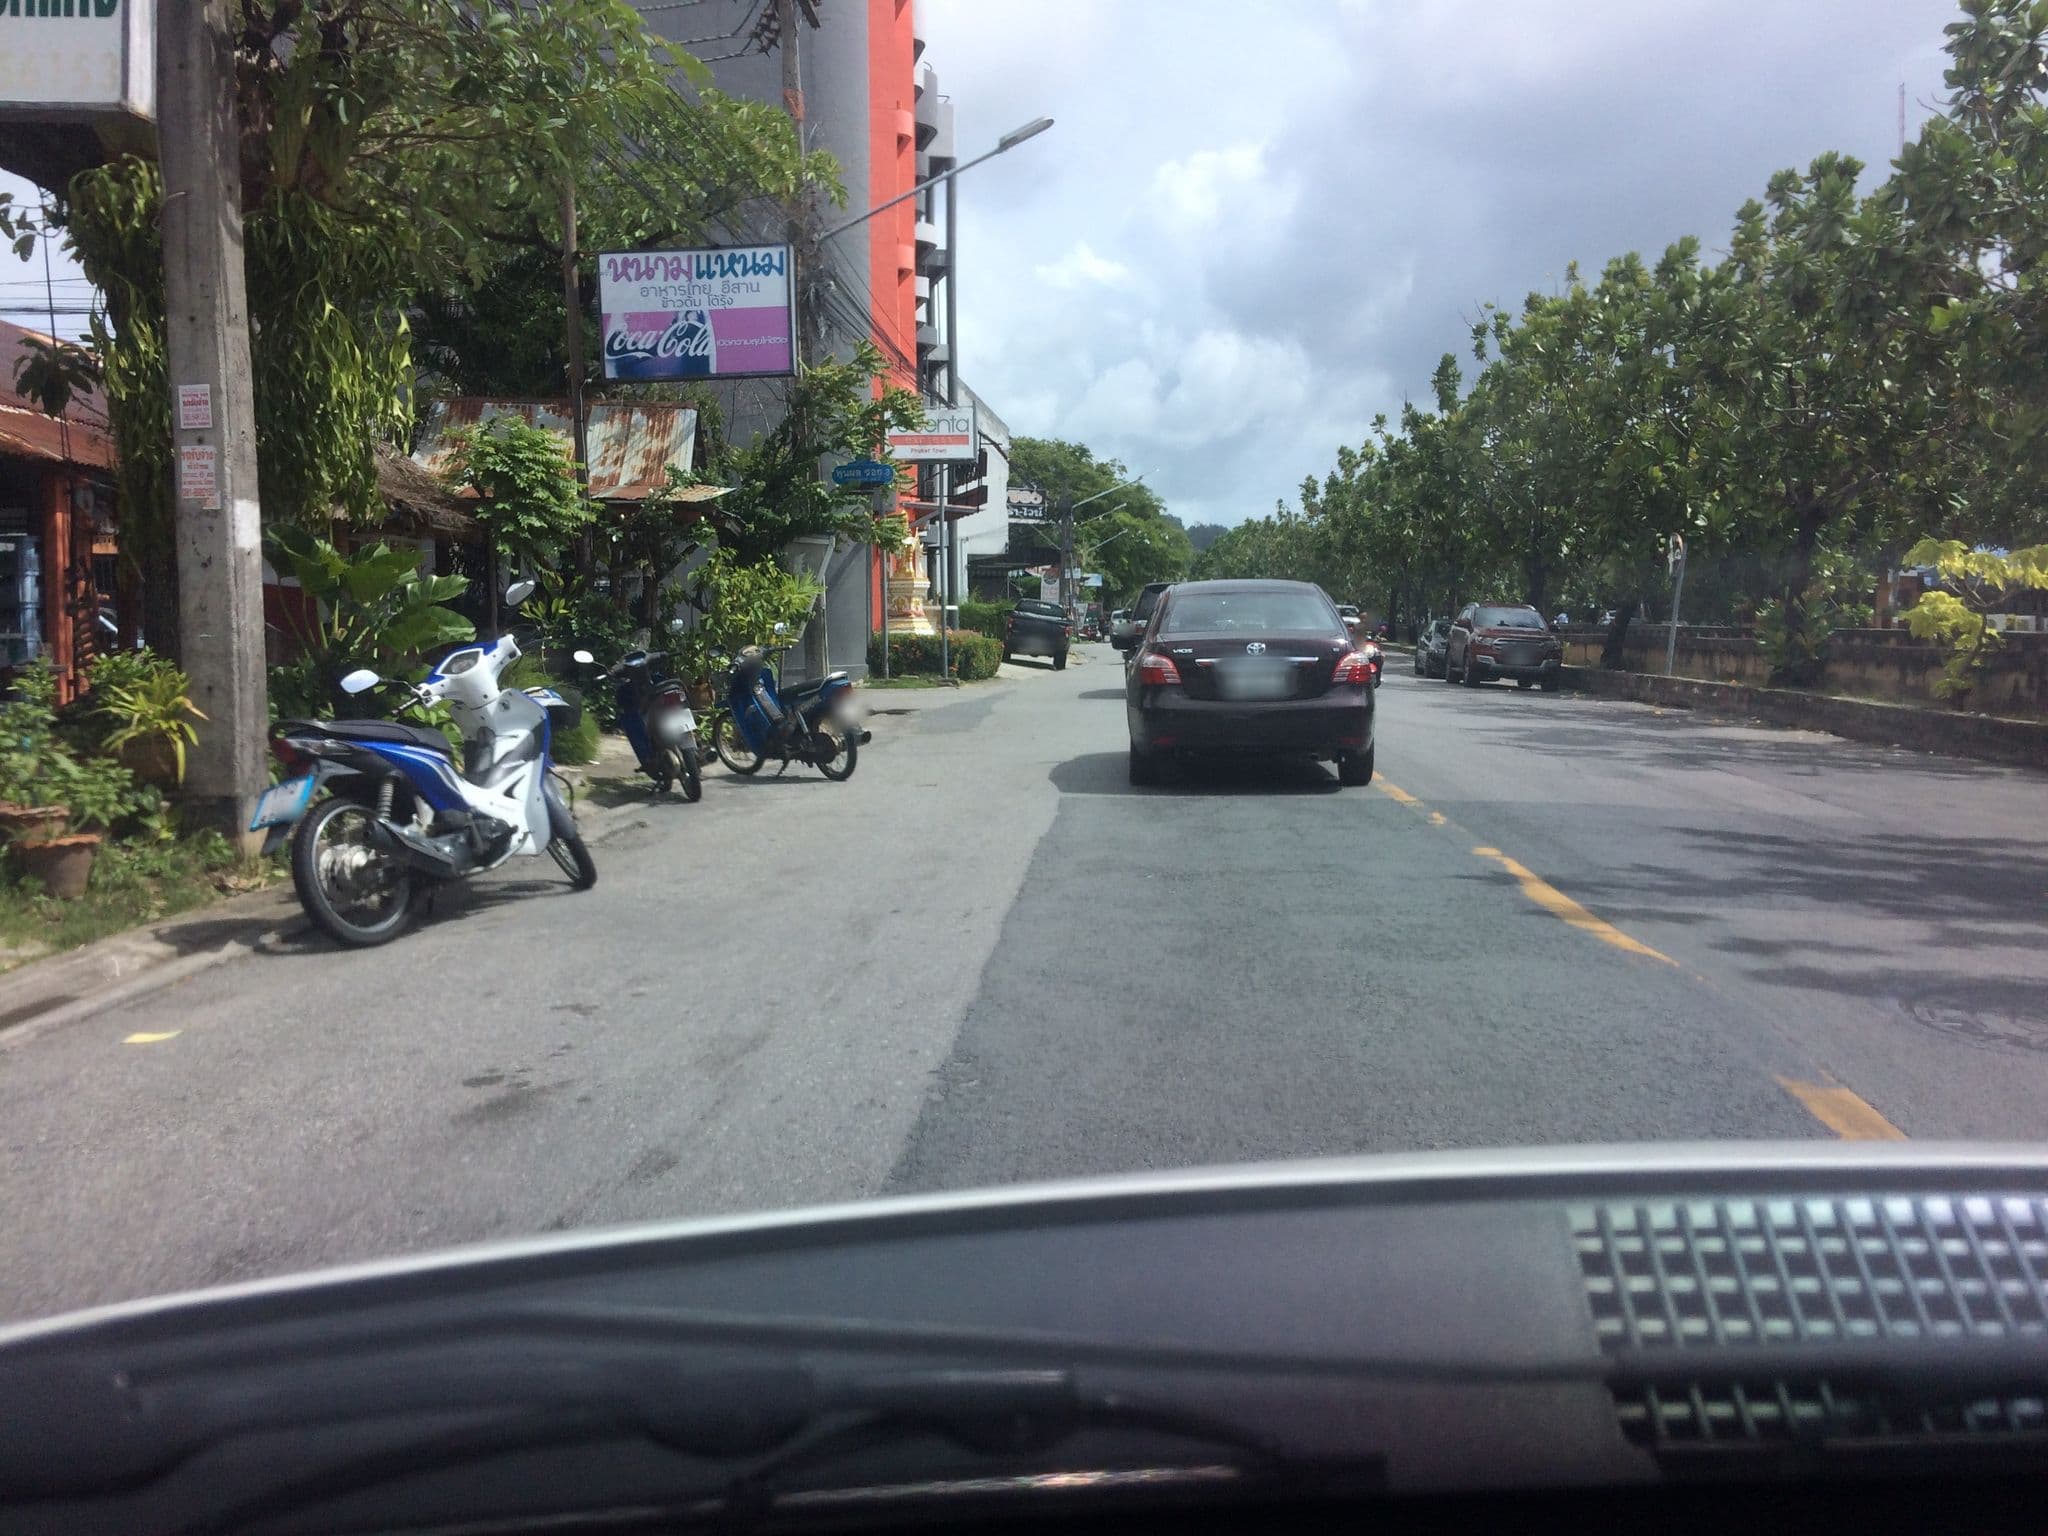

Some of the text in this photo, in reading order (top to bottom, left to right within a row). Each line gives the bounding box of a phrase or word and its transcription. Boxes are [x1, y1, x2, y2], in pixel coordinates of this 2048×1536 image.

[640, 279, 761, 298] อาหารไทย อีสาน
[661, 296, 702, 309] ข้าวต้ม
